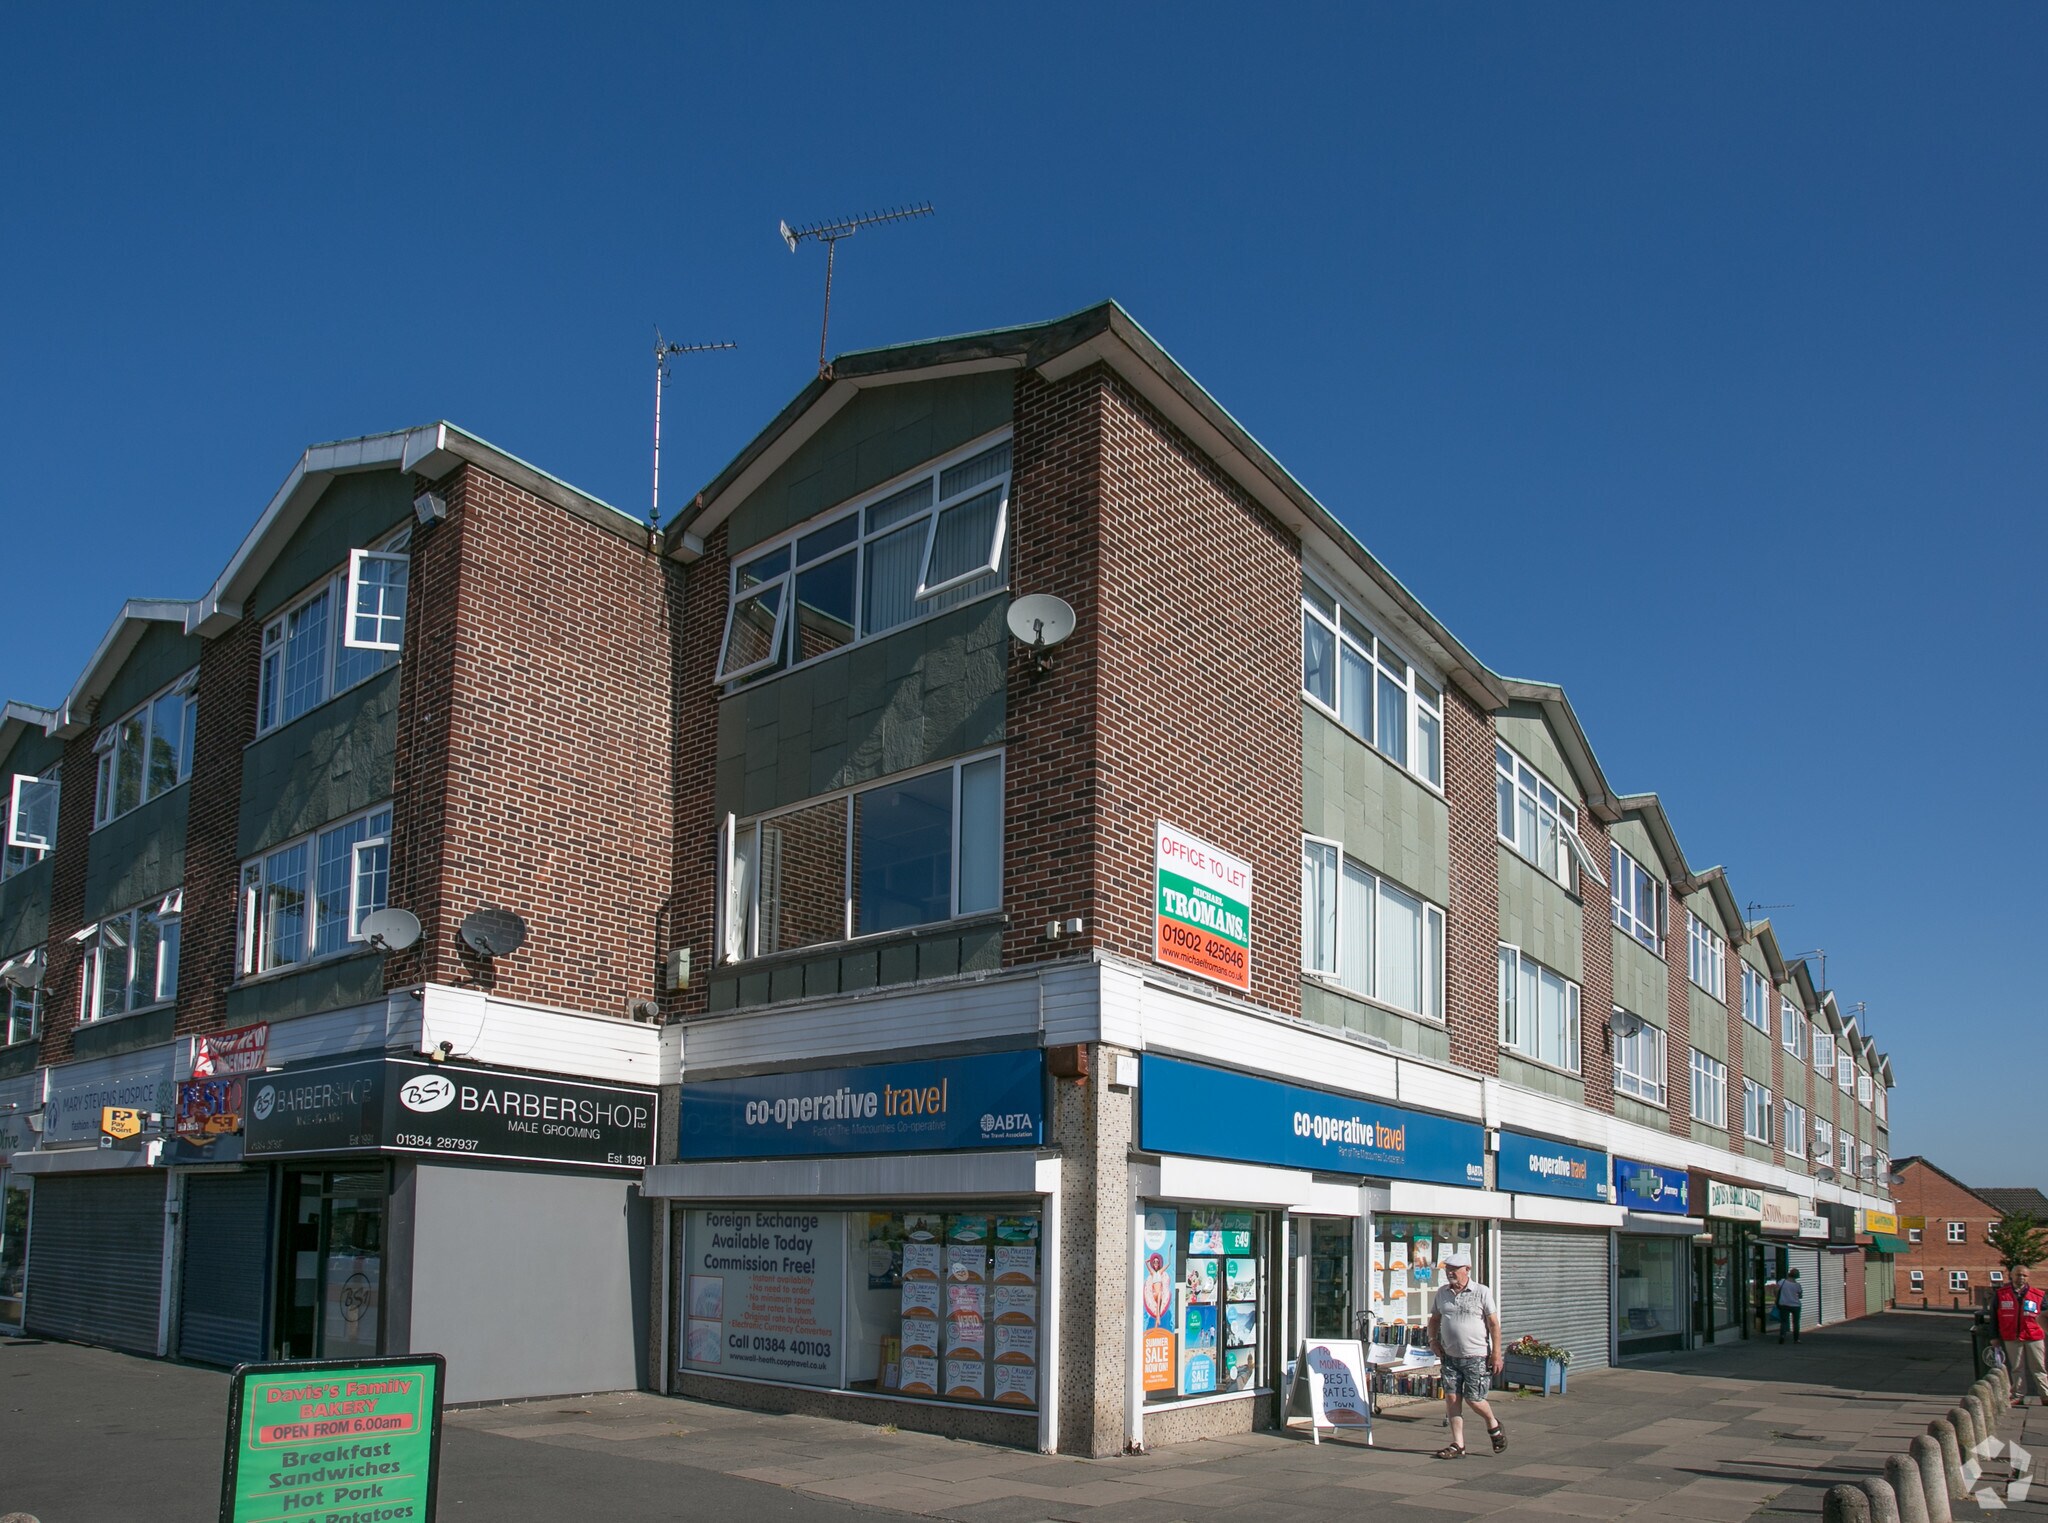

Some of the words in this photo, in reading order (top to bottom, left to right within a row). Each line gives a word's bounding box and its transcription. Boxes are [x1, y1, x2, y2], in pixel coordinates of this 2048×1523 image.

[1162, 837, 1206, 870] OFFICE
[1209, 858, 1224, 878] TO
[1227, 866, 1247, 889] LET
[1193, 886, 1224, 906] MICHAEL
[1163, 887, 1244, 943] TROMANS
[1162, 923, 1201, 952] 01902
[1205, 940, 1244, 969] 425646
[1162, 947, 1244, 981] www.michaeltromans.co.uk
[238, 1026, 267, 1050] NEW
[62, 1096, 83, 1112] MARY
[84, 1091, 117, 1110] STEVENS
[118, 1084, 154, 1106] HOSPICE
[401, 1080, 450, 1105] BS1
[461, 1086, 647, 1128] BARBERSHOP
[884, 1078, 948, 1117] travel
[111, 1126, 132, 1134] Point
[508, 1120, 539, 1134] MALE
[542, 1124, 601, 1140] GROOMING
[897, 1119, 946, 1133] Co-operative
[994, 1113, 1033, 1130] ABTA
[396, 1133, 433, 1147] 01384
[437, 1137, 479, 1151] 287937
[1376, 1121, 1405, 1151] travel
[608, 1153, 622, 1164] Est
[627, 1155, 647, 1165] 1991
[1570, 1158, 1587, 1179] travel
[706, 1212, 751, 1231] Foreign
[756, 1212, 819, 1233] Exchange
[712, 1233, 770, 1250] Available
[774, 1235, 813, 1255] Today
[1234, 1231, 1249, 1248] £49
[704, 1254, 778, 1272] Commission
[783, 1257, 816, 1274] Free!
[752, 1274, 776, 1282] Instant
[777, 1275, 814, 1286] availability
[764, 1284, 781, 1293] need
[783, 1286, 790, 1294] to
[791, 1286, 810, 1295] order
[749, 1293, 760, 1301] No
[761, 1295, 792, 1303] minimum
[795, 1296, 815, 1306] spend
[751, 1303, 766, 1311] Best
[767, 1304, 784, 1313] rates
[795, 1306, 812, 1315] town
[731, 1319, 762, 1330] Electronic
[764, 1323, 793, 1334] Currency
[795, 1326, 833, 1337] Converters
[743, 1311, 770, 1323] Original
[772, 1314, 786, 1322] rate
[787, 1315, 817, 1327] buyback
[729, 1334, 749, 1349] Call
[753, 1337, 786, 1353] 01384
[790, 1341, 831, 1358] 401103
[1145, 1338, 1168, 1348] SUMMER
[729, 1353, 827, 1371] www.wall-heath.cooptravel.co.uk
[1145, 1346, 1169, 1363] SALE
[1145, 1363, 1158, 1373] NOW
[1158, 1362, 1168, 1372] ON!
[1191, 1369, 1209, 1383] SALE
[1324, 1373, 1349, 1385] BEST
[266, 1384, 340, 1404] Davis's
[346, 1379, 412, 1397] Family
[1323, 1387, 1355, 1397] RATES
[300, 1398, 379, 1419] BAKERY
[273, 1425, 309, 1440] OPEN
[314, 1420, 349, 1436] FROM
[354, 1417, 401, 1431] 6.00am
[282, 1442, 391, 1468] Breakfast
[269, 1461, 401, 1488] Sandwiches
[283, 1491, 325, 1512] Hot
[334, 1484, 384, 1503] Pork
[325, 1505, 414, 1523] Potatoes
